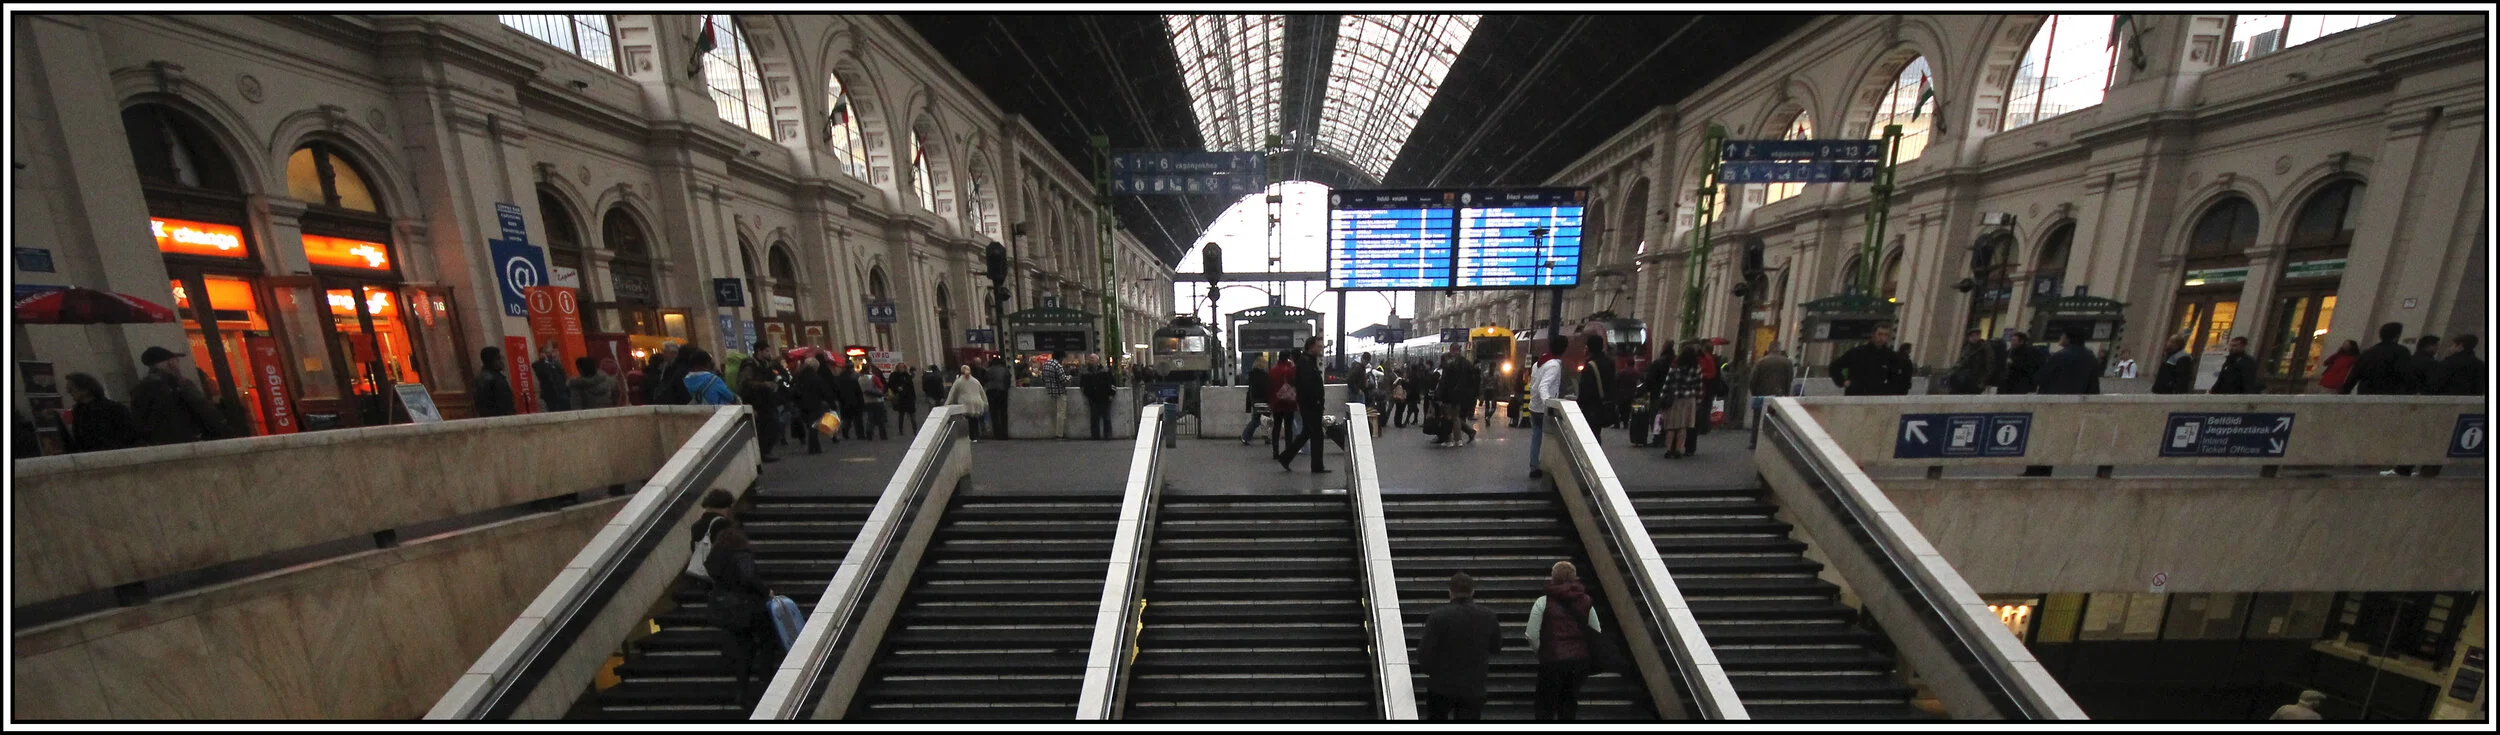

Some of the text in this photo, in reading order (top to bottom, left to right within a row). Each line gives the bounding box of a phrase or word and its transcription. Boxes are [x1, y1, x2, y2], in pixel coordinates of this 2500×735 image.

[1821, 146, 1830, 157] 9
[1845, 146, 1858, 157] 13
[1160, 158, 1168, 169] 6
[173, 227, 239, 250] change
[1047, 299, 1054, 308] 6
[266, 364, 290, 427] change
[2202, 437, 2228, 445] Inland
[2201, 445, 2260, 454] Ticket Offices
